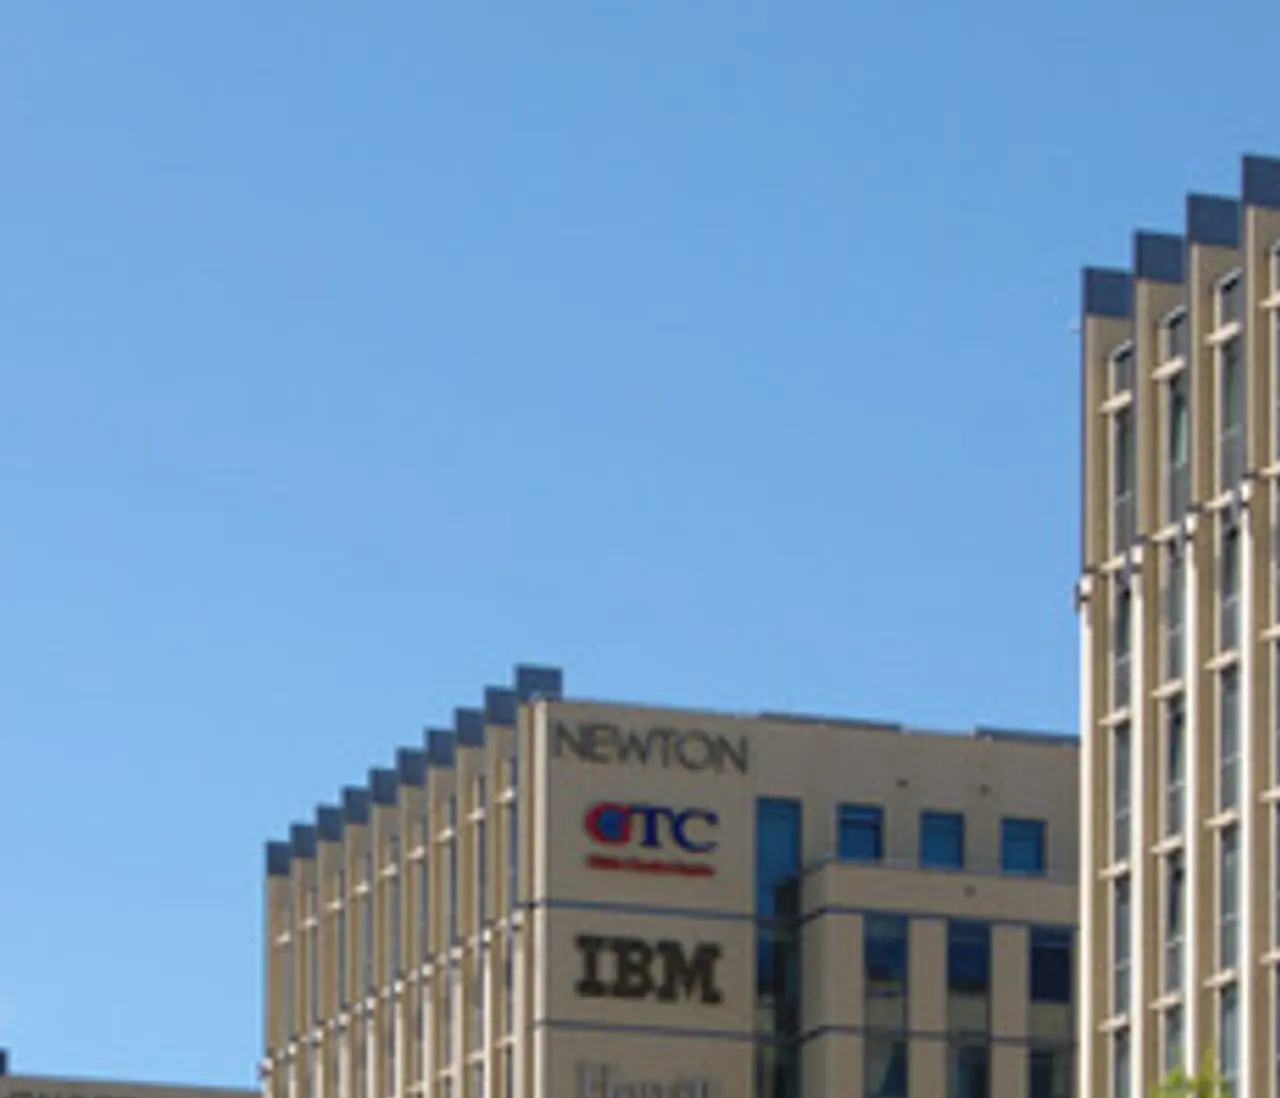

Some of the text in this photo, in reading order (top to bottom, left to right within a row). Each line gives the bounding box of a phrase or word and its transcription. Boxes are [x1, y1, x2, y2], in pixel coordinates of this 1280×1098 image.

[552, 718, 748, 776] NEWTON
[584, 801, 719, 853] GTC
[575, 934, 724, 1004] IBM
